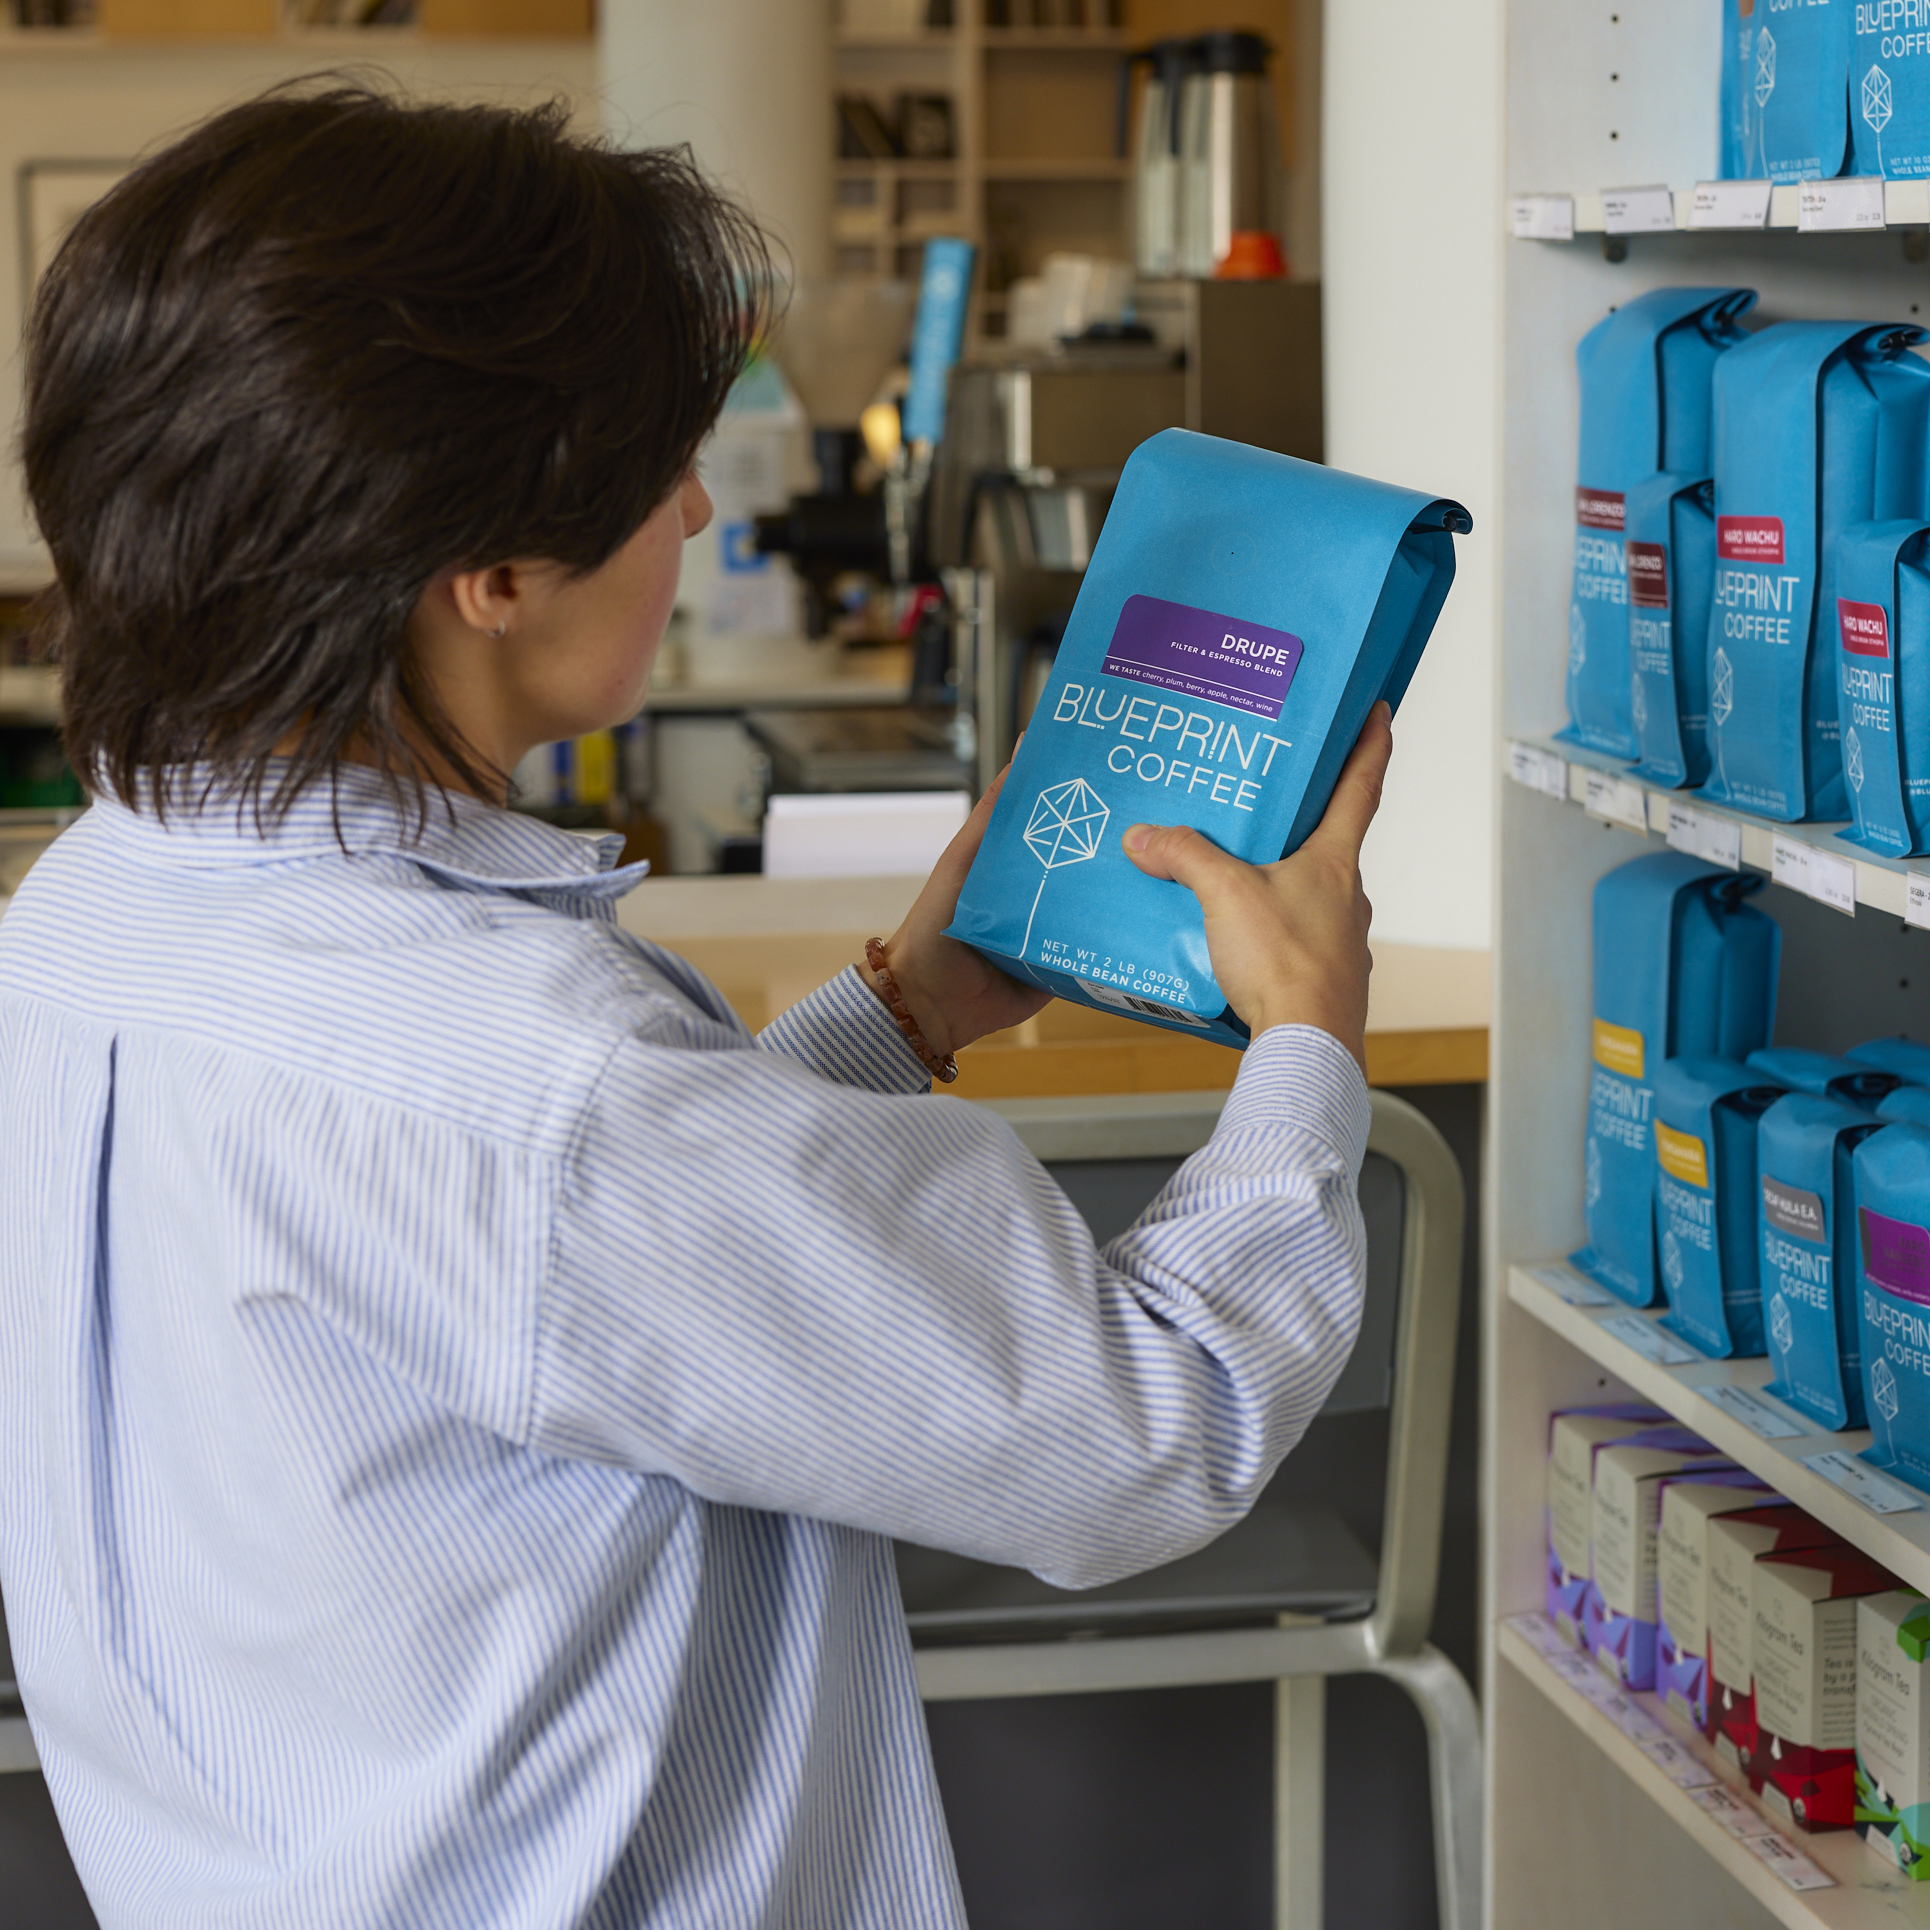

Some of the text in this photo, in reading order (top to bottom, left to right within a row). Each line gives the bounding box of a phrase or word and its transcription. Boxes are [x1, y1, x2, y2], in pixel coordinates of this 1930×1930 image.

[1723, 529, 1779, 545] HARO WACHU
[1724, 611, 1791, 644] COFFEE
[1857, 617, 1883, 636] WACHU
[1170, 641, 1199, 655] FILTER
[1208, 650, 1252, 668] ESPRESSO
[1254, 663, 1283, 678] BLEND
[1220, 633, 1290, 666] DRUPE
[1109, 663, 1273, 713] WE TASTE cherry, plum, berry, apple, nectar, wine
[1053, 683, 1292, 777] BLUEPRINT
[1852, 702, 1890, 732] COFFEE
[1107, 744, 1262, 812] COFFEE
[1040, 951, 1090, 974] WHOLE
[1092, 967, 1130, 986] BEAN
[1133, 979, 1187, 1004] COFFEE
[1043, 938, 1190, 992] NET WT 2 LB (907G)
[1779, 1272, 1829, 1311] COFFEE
[1861, 1649, 1911, 1697] Kilogram Tea
